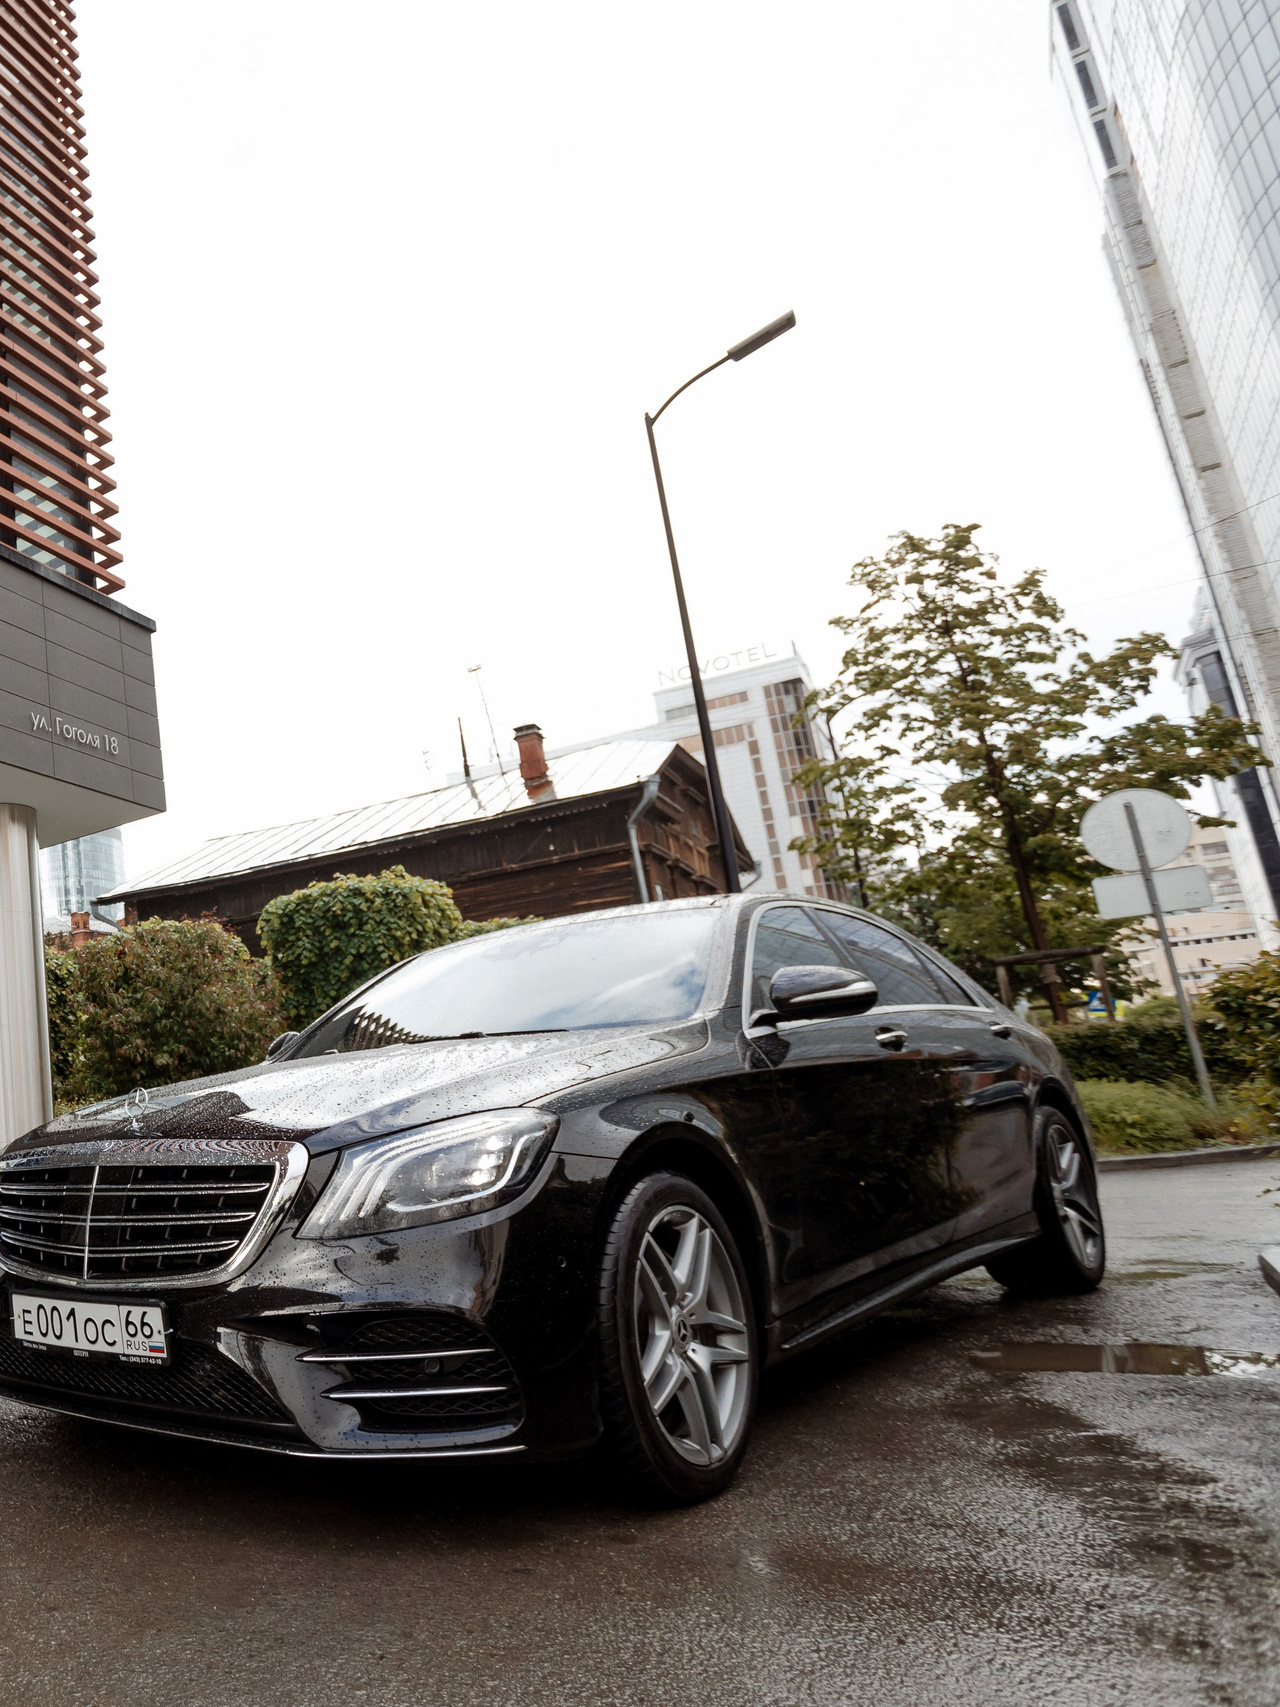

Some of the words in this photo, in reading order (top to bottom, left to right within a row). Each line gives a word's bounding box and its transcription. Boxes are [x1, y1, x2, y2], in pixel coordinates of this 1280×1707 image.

[31, 711, 52, 732] ул.
[55, 717, 100, 748] Гоголя
[104, 734, 119, 755] 18
[125, 1310, 154, 1339] 66
[126, 1339, 148, 1352] RUS
